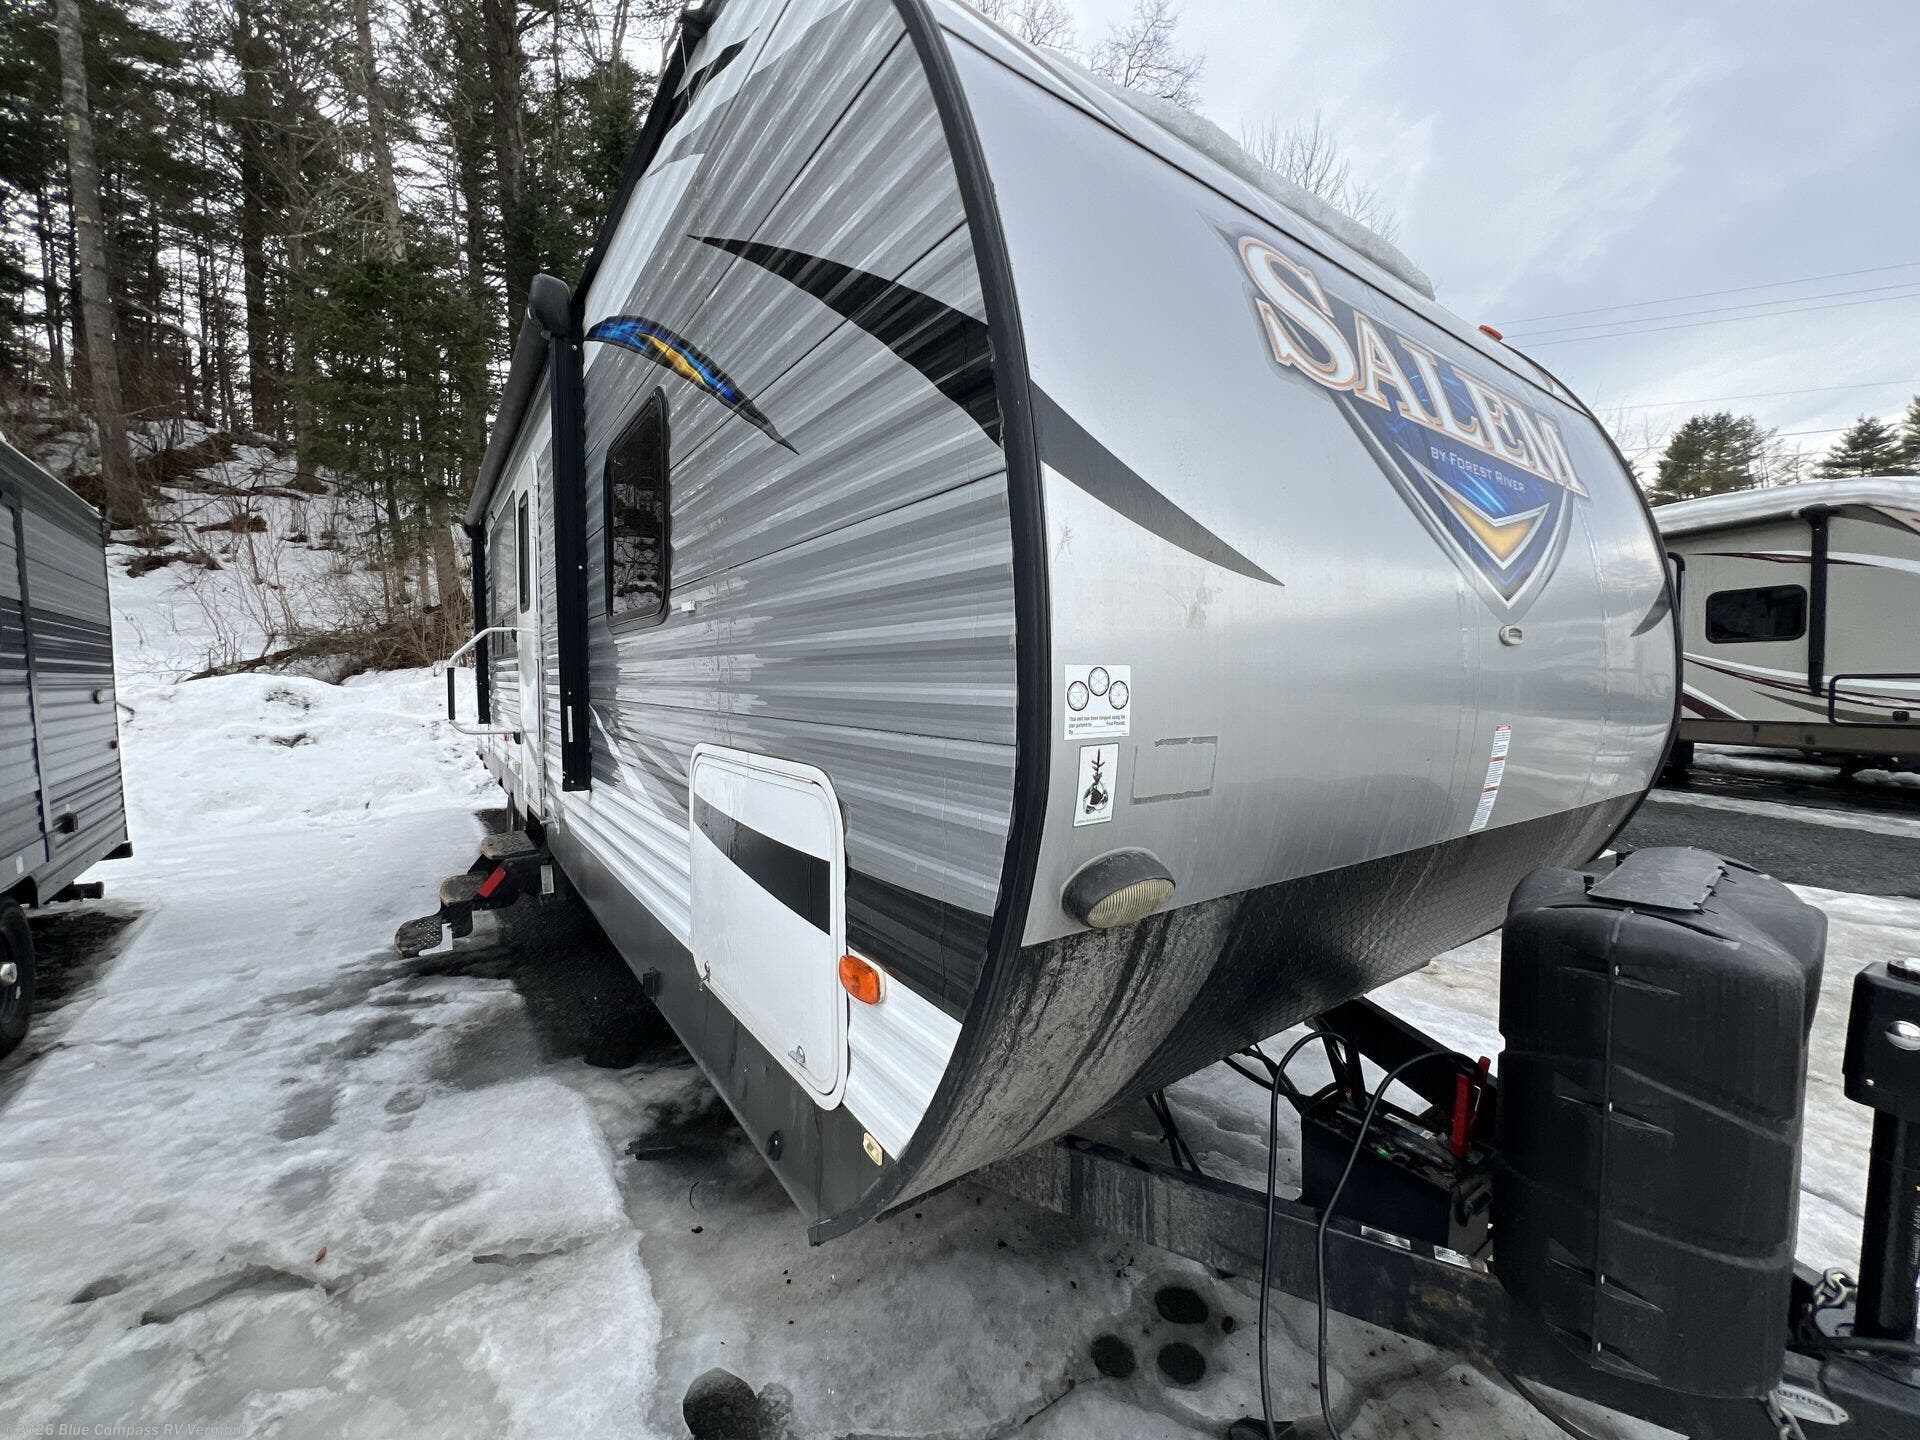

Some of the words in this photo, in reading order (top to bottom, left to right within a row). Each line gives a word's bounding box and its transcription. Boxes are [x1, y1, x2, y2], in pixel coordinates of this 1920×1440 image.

[1238, 235, 1590, 499] SALEM
[1430, 446, 1446, 462] BY
[1449, 452, 1493, 480] FOREST
[1495, 471, 1526, 493] RIVER
